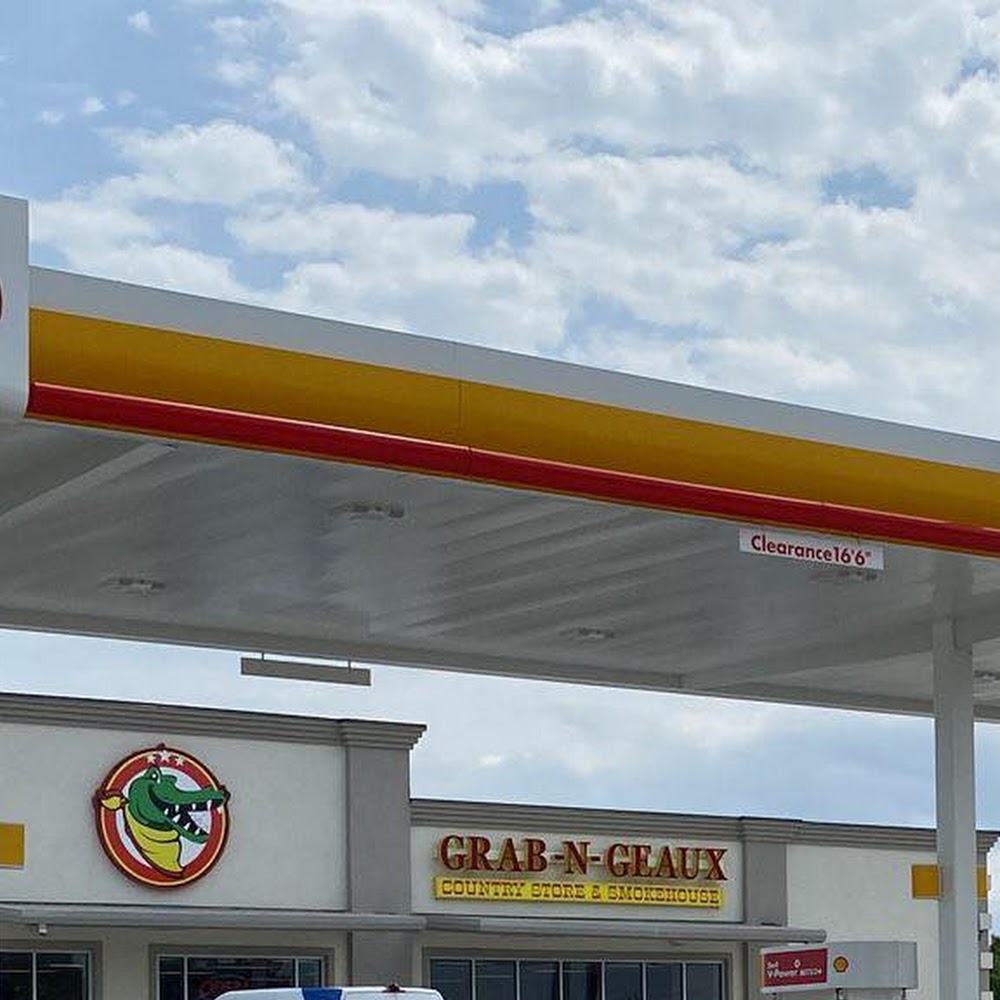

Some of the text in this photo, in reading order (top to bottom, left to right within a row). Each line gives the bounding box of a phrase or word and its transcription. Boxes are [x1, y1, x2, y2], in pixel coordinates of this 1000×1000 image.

[440, 834, 728, 880] GRAB-N-GEAUX
[441, 880, 720, 904] COUNTRY STORE & SMOKEHOUSE
